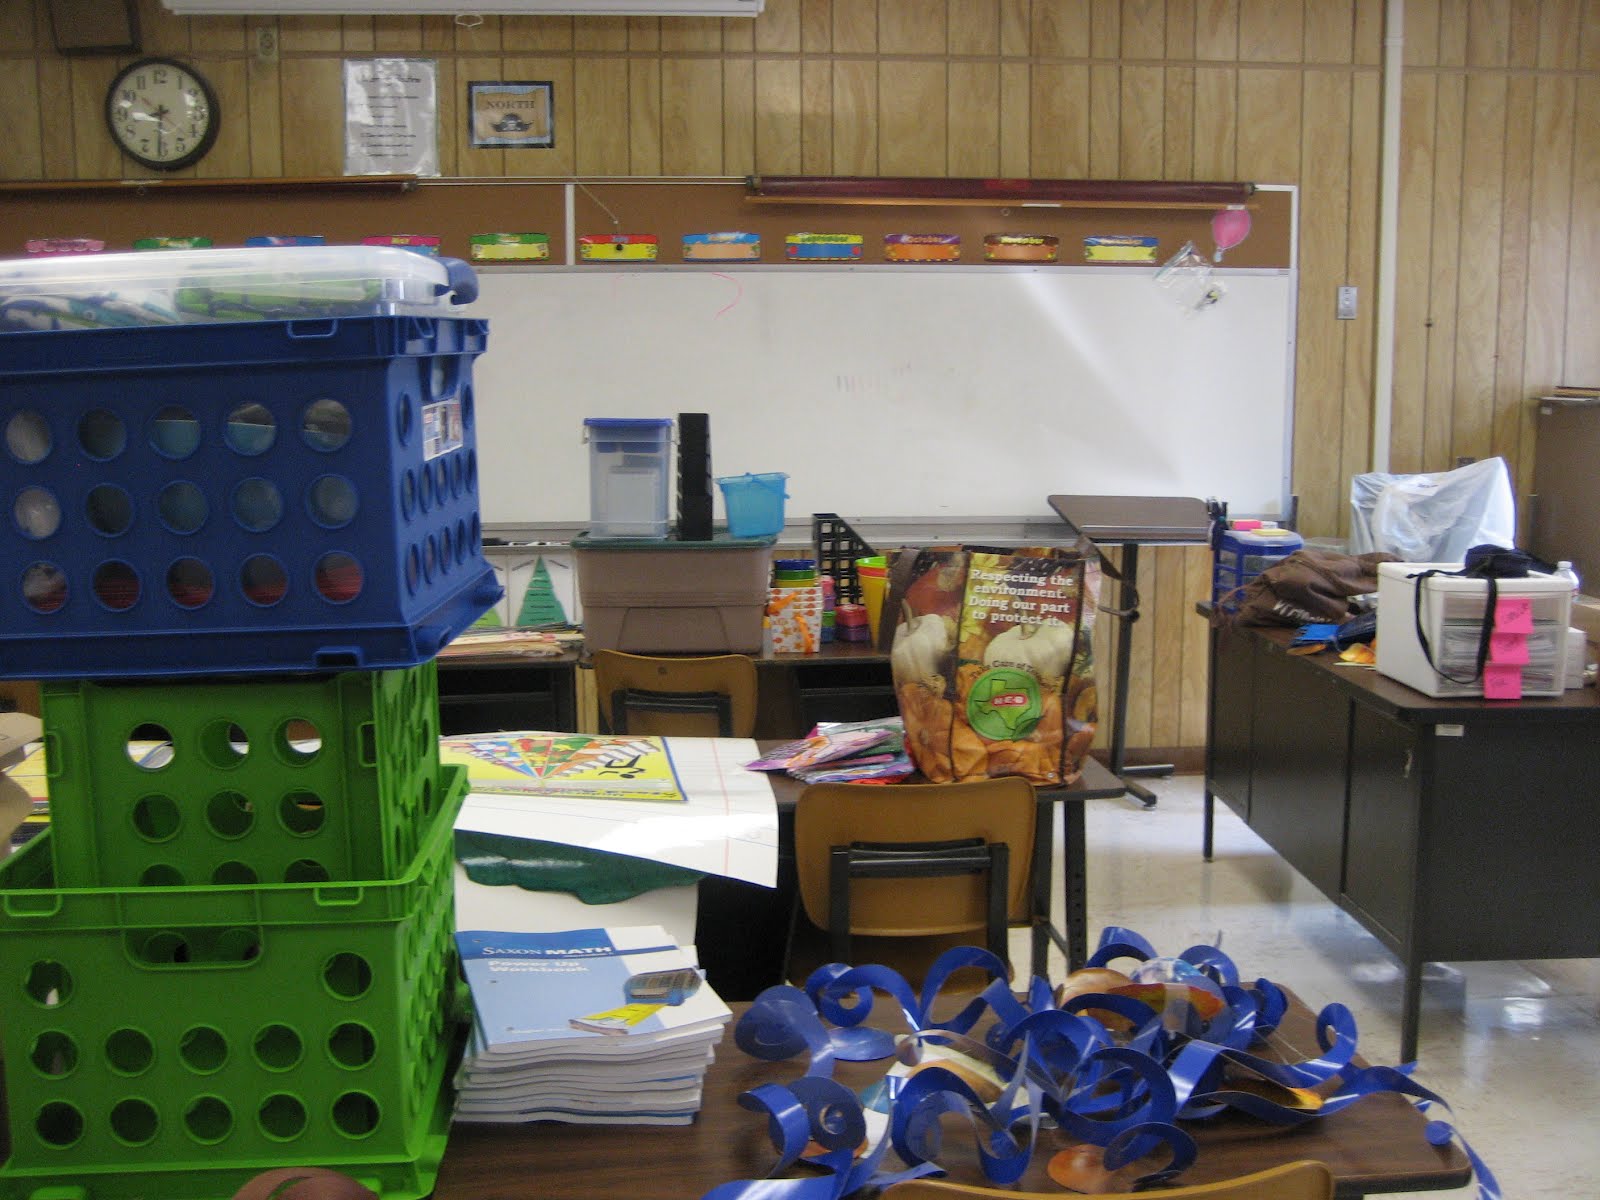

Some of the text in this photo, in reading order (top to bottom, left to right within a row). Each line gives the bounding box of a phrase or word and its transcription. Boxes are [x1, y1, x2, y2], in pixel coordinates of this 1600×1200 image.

[153, 69, 167, 84] 12
[485, 100, 535, 110] NORTH
[970, 569, 1074, 587] Respecting the
[974, 582, 1067, 599] environment.
[968, 596, 1071, 614] Doing our part
[972, 610, 987, 620] to
[990, 612, 1043, 625] protect
[545, 946, 612, 955] MATH
